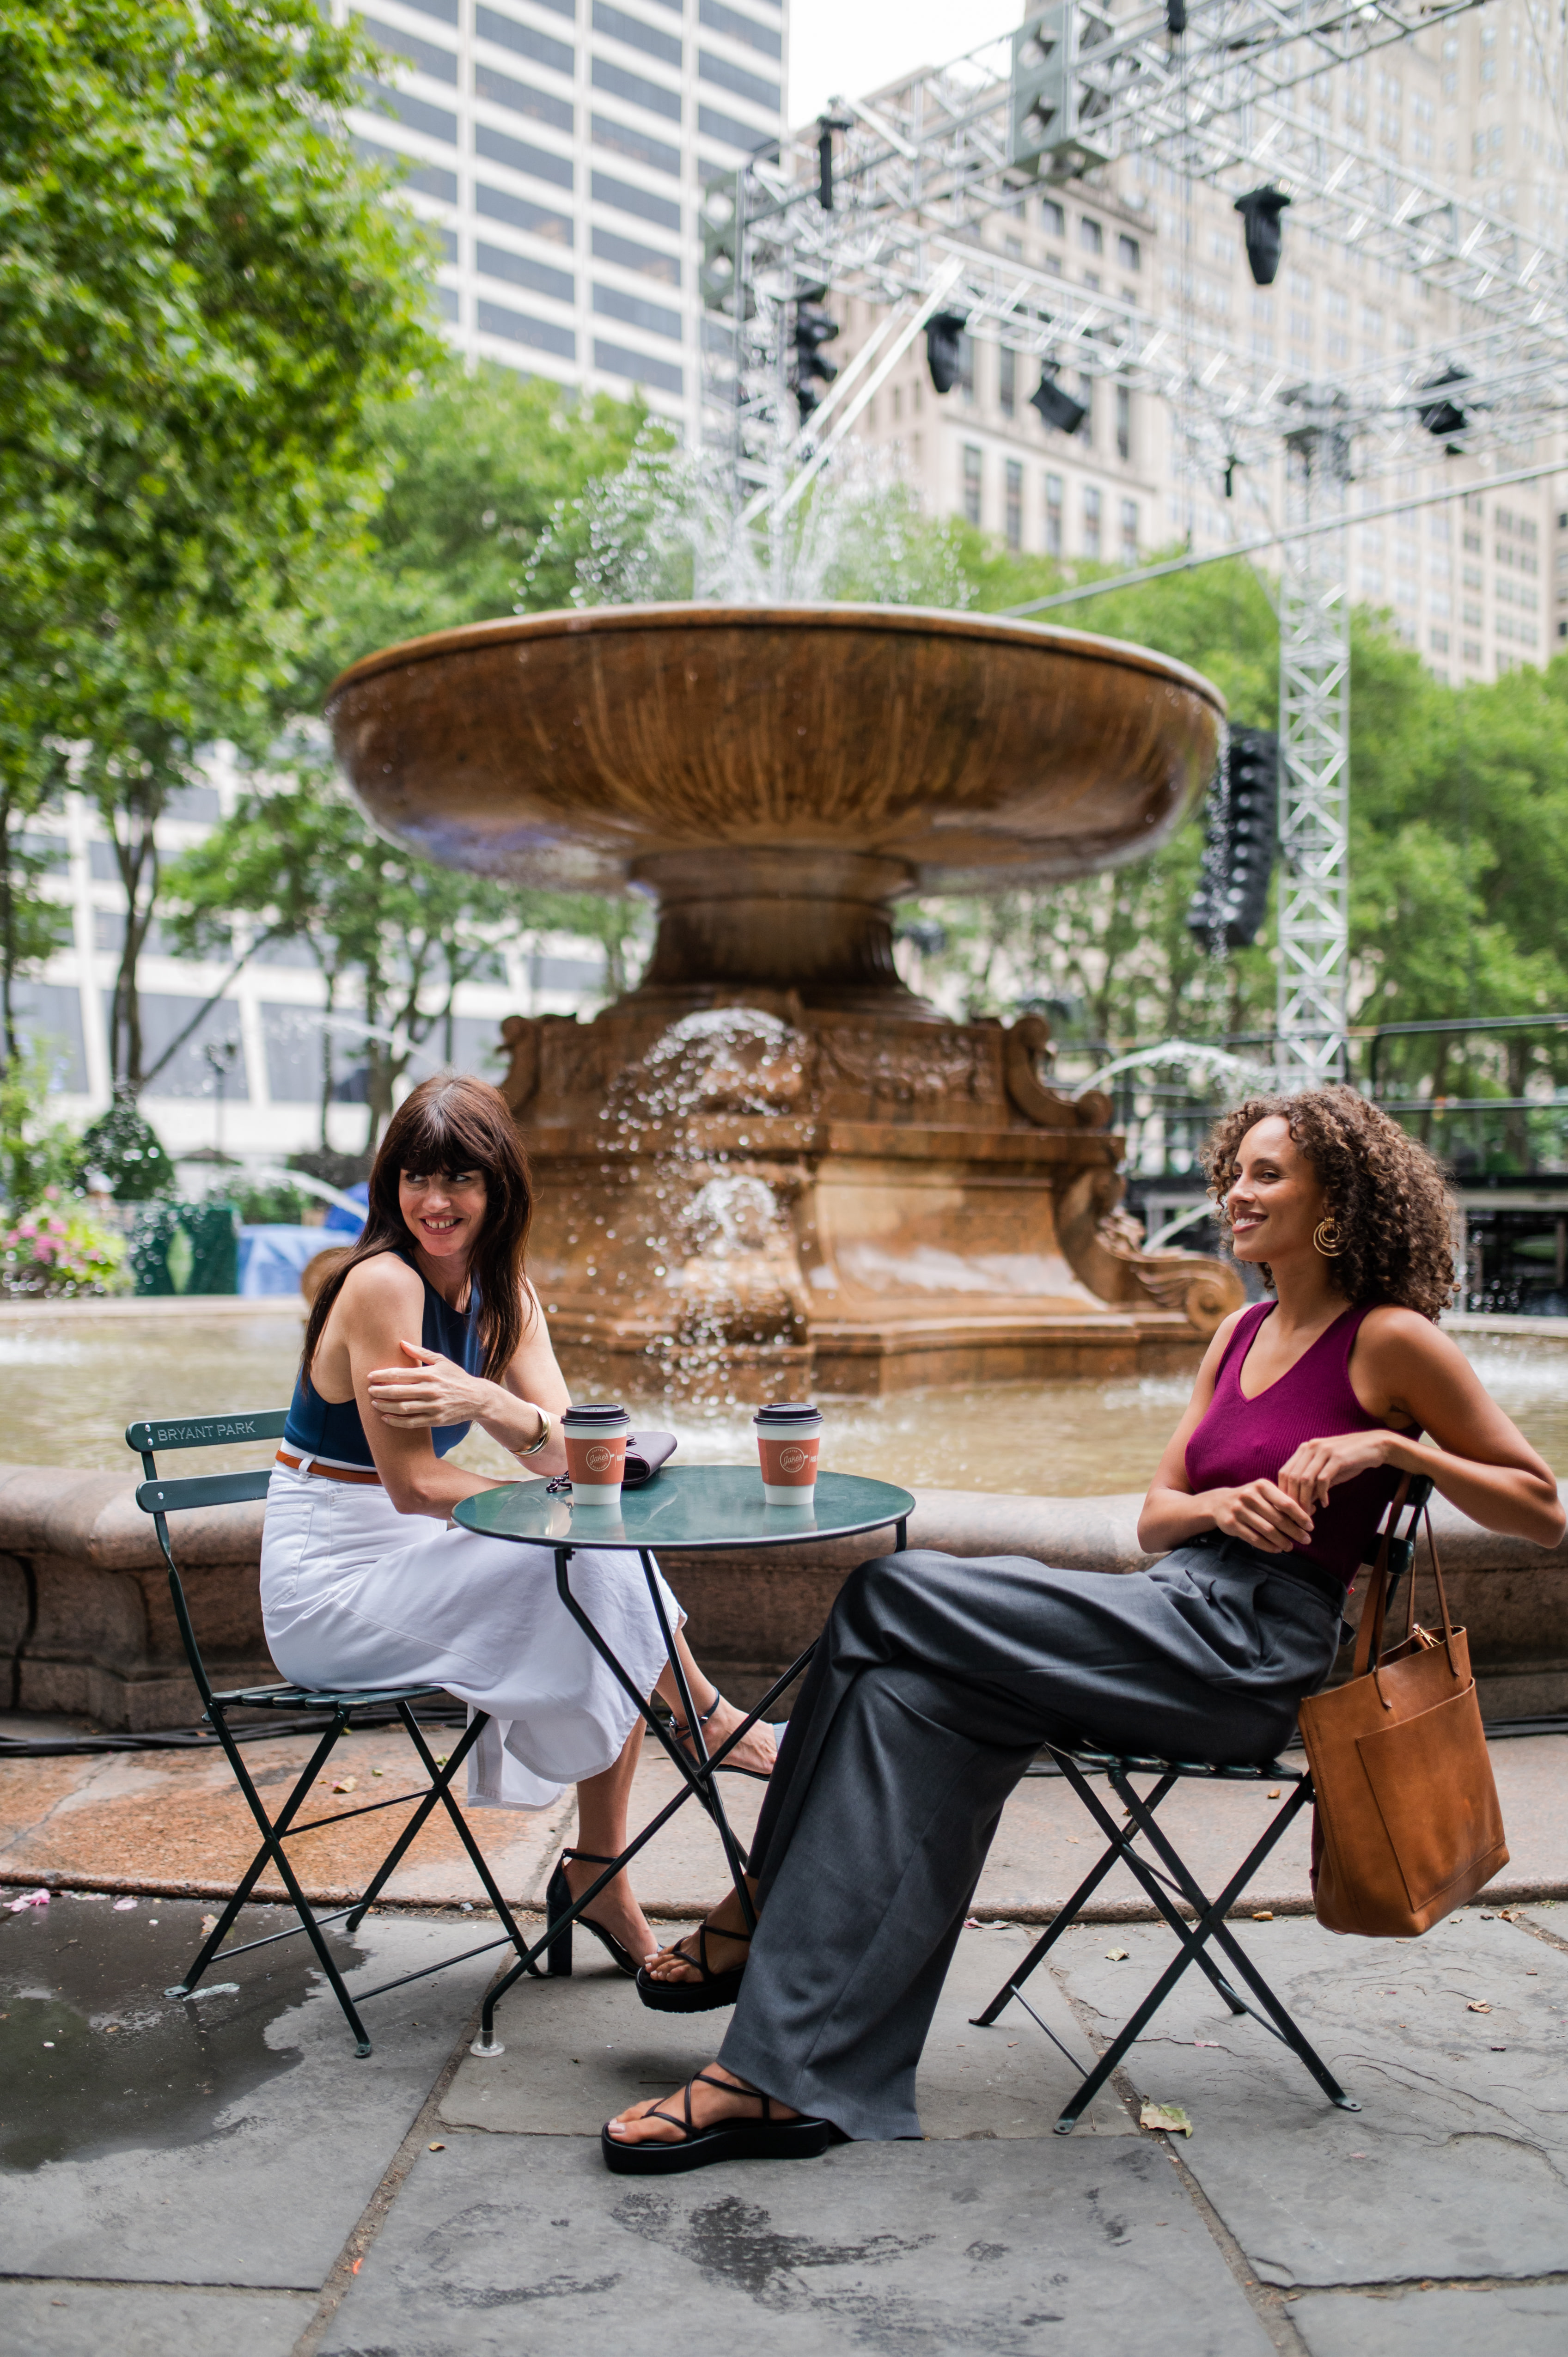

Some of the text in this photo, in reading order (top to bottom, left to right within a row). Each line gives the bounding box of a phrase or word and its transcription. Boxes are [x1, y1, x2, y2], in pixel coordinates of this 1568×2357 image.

[158, 1421, 256, 1441] BRYANT PARK
[589, 1453, 609, 1465] Jake's
[783, 1453, 802, 1467] Jake's
